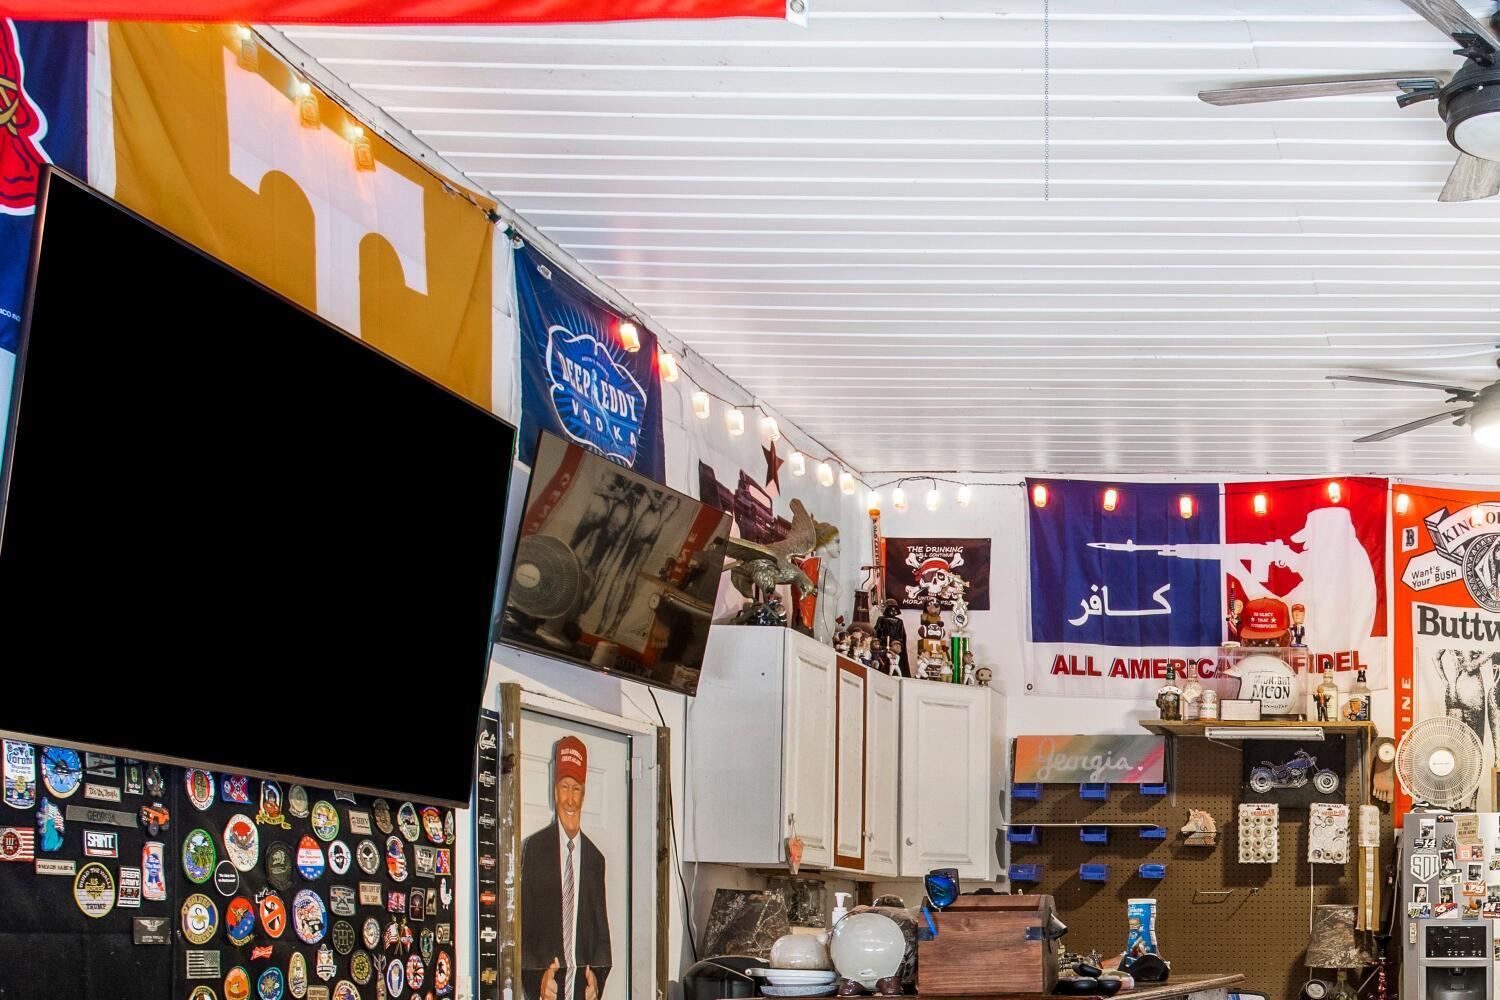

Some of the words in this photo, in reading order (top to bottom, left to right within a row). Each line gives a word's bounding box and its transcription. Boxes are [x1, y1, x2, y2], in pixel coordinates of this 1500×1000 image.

[558, 351, 591, 398] DEEP
[600, 380, 638, 422] EDDY
[907, 545, 924, 553] THE
[925, 545, 964, 554] DRINKING
[1411, 565, 1440, 579] Want's
[1412, 578, 1430, 589] Your
[1434, 569, 1457, 582] BUSH
[1050, 654, 1102, 676] ALL
[1252, 684, 1291, 700] MOON
[1036, 737, 1134, 782] Georgia
[121, 871, 140, 879] BEER
[121, 878, 140, 887] ARMY
[85, 902, 107, 910] TRUMP
